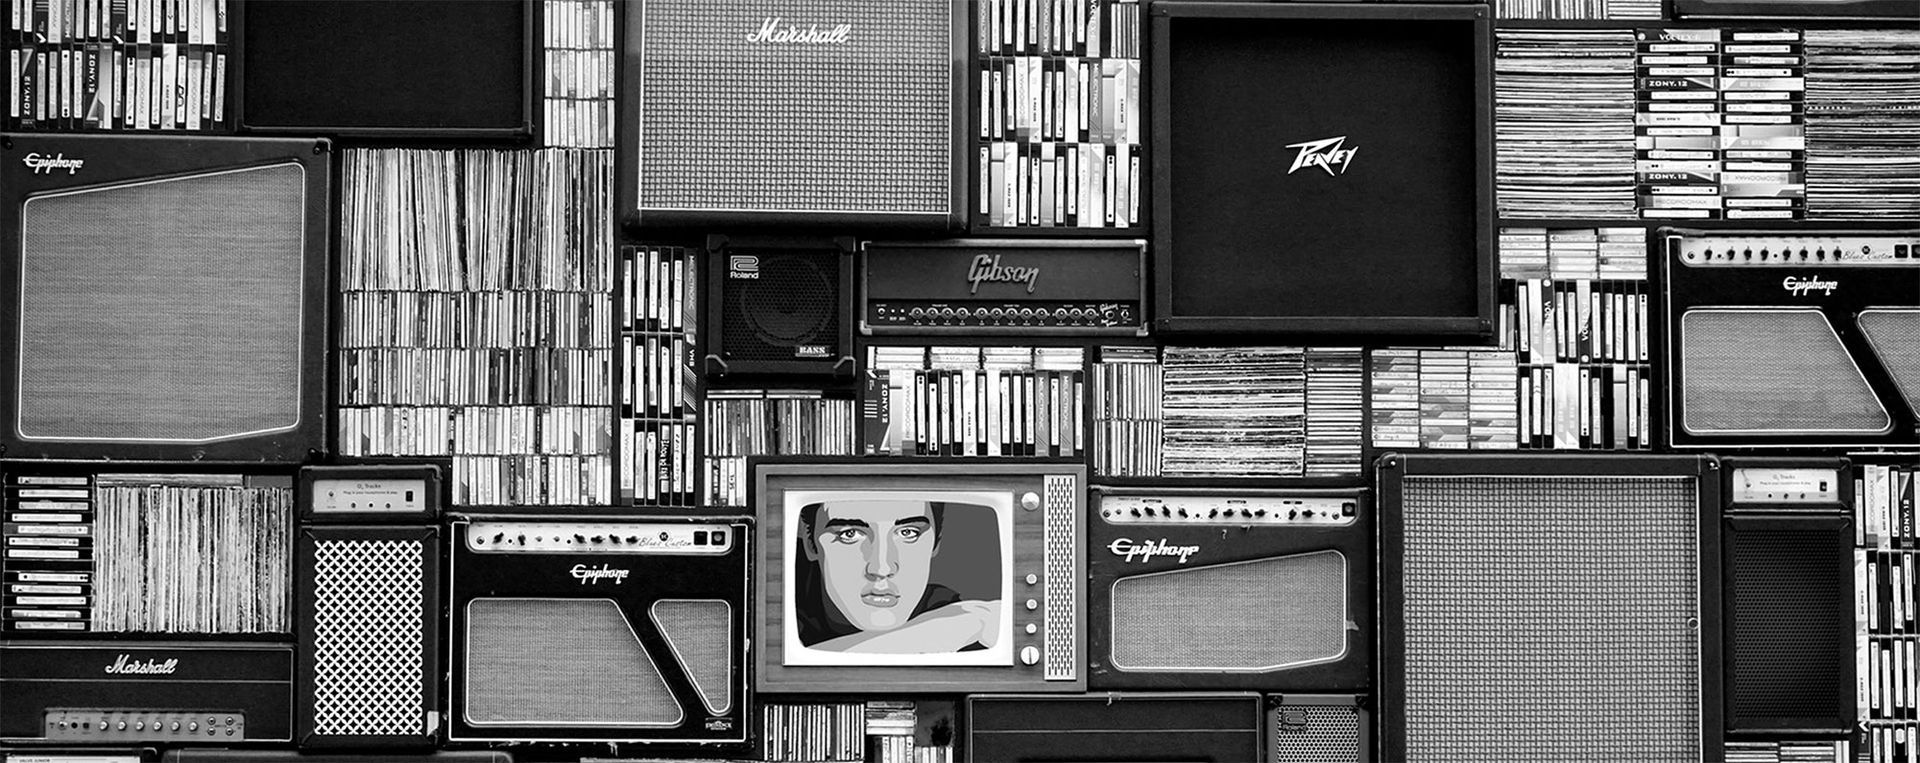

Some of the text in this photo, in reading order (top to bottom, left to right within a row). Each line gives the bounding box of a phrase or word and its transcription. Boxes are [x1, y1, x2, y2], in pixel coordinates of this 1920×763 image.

[747, 17, 852, 44] Marshall
[23, 152, 84, 175] Epiphone
[1285, 136, 1359, 176] PEAVEY
[730, 271, 759, 279] Roland
[967, 254, 1039, 294] Gibson
[1783, 275, 1838, 296] Epiphone
[800, 346, 826, 354] BASS
[1107, 538, 1200, 563] Epiphone
[569, 563, 629, 584] Epiphone
[104, 654, 179, 674] Marshall
